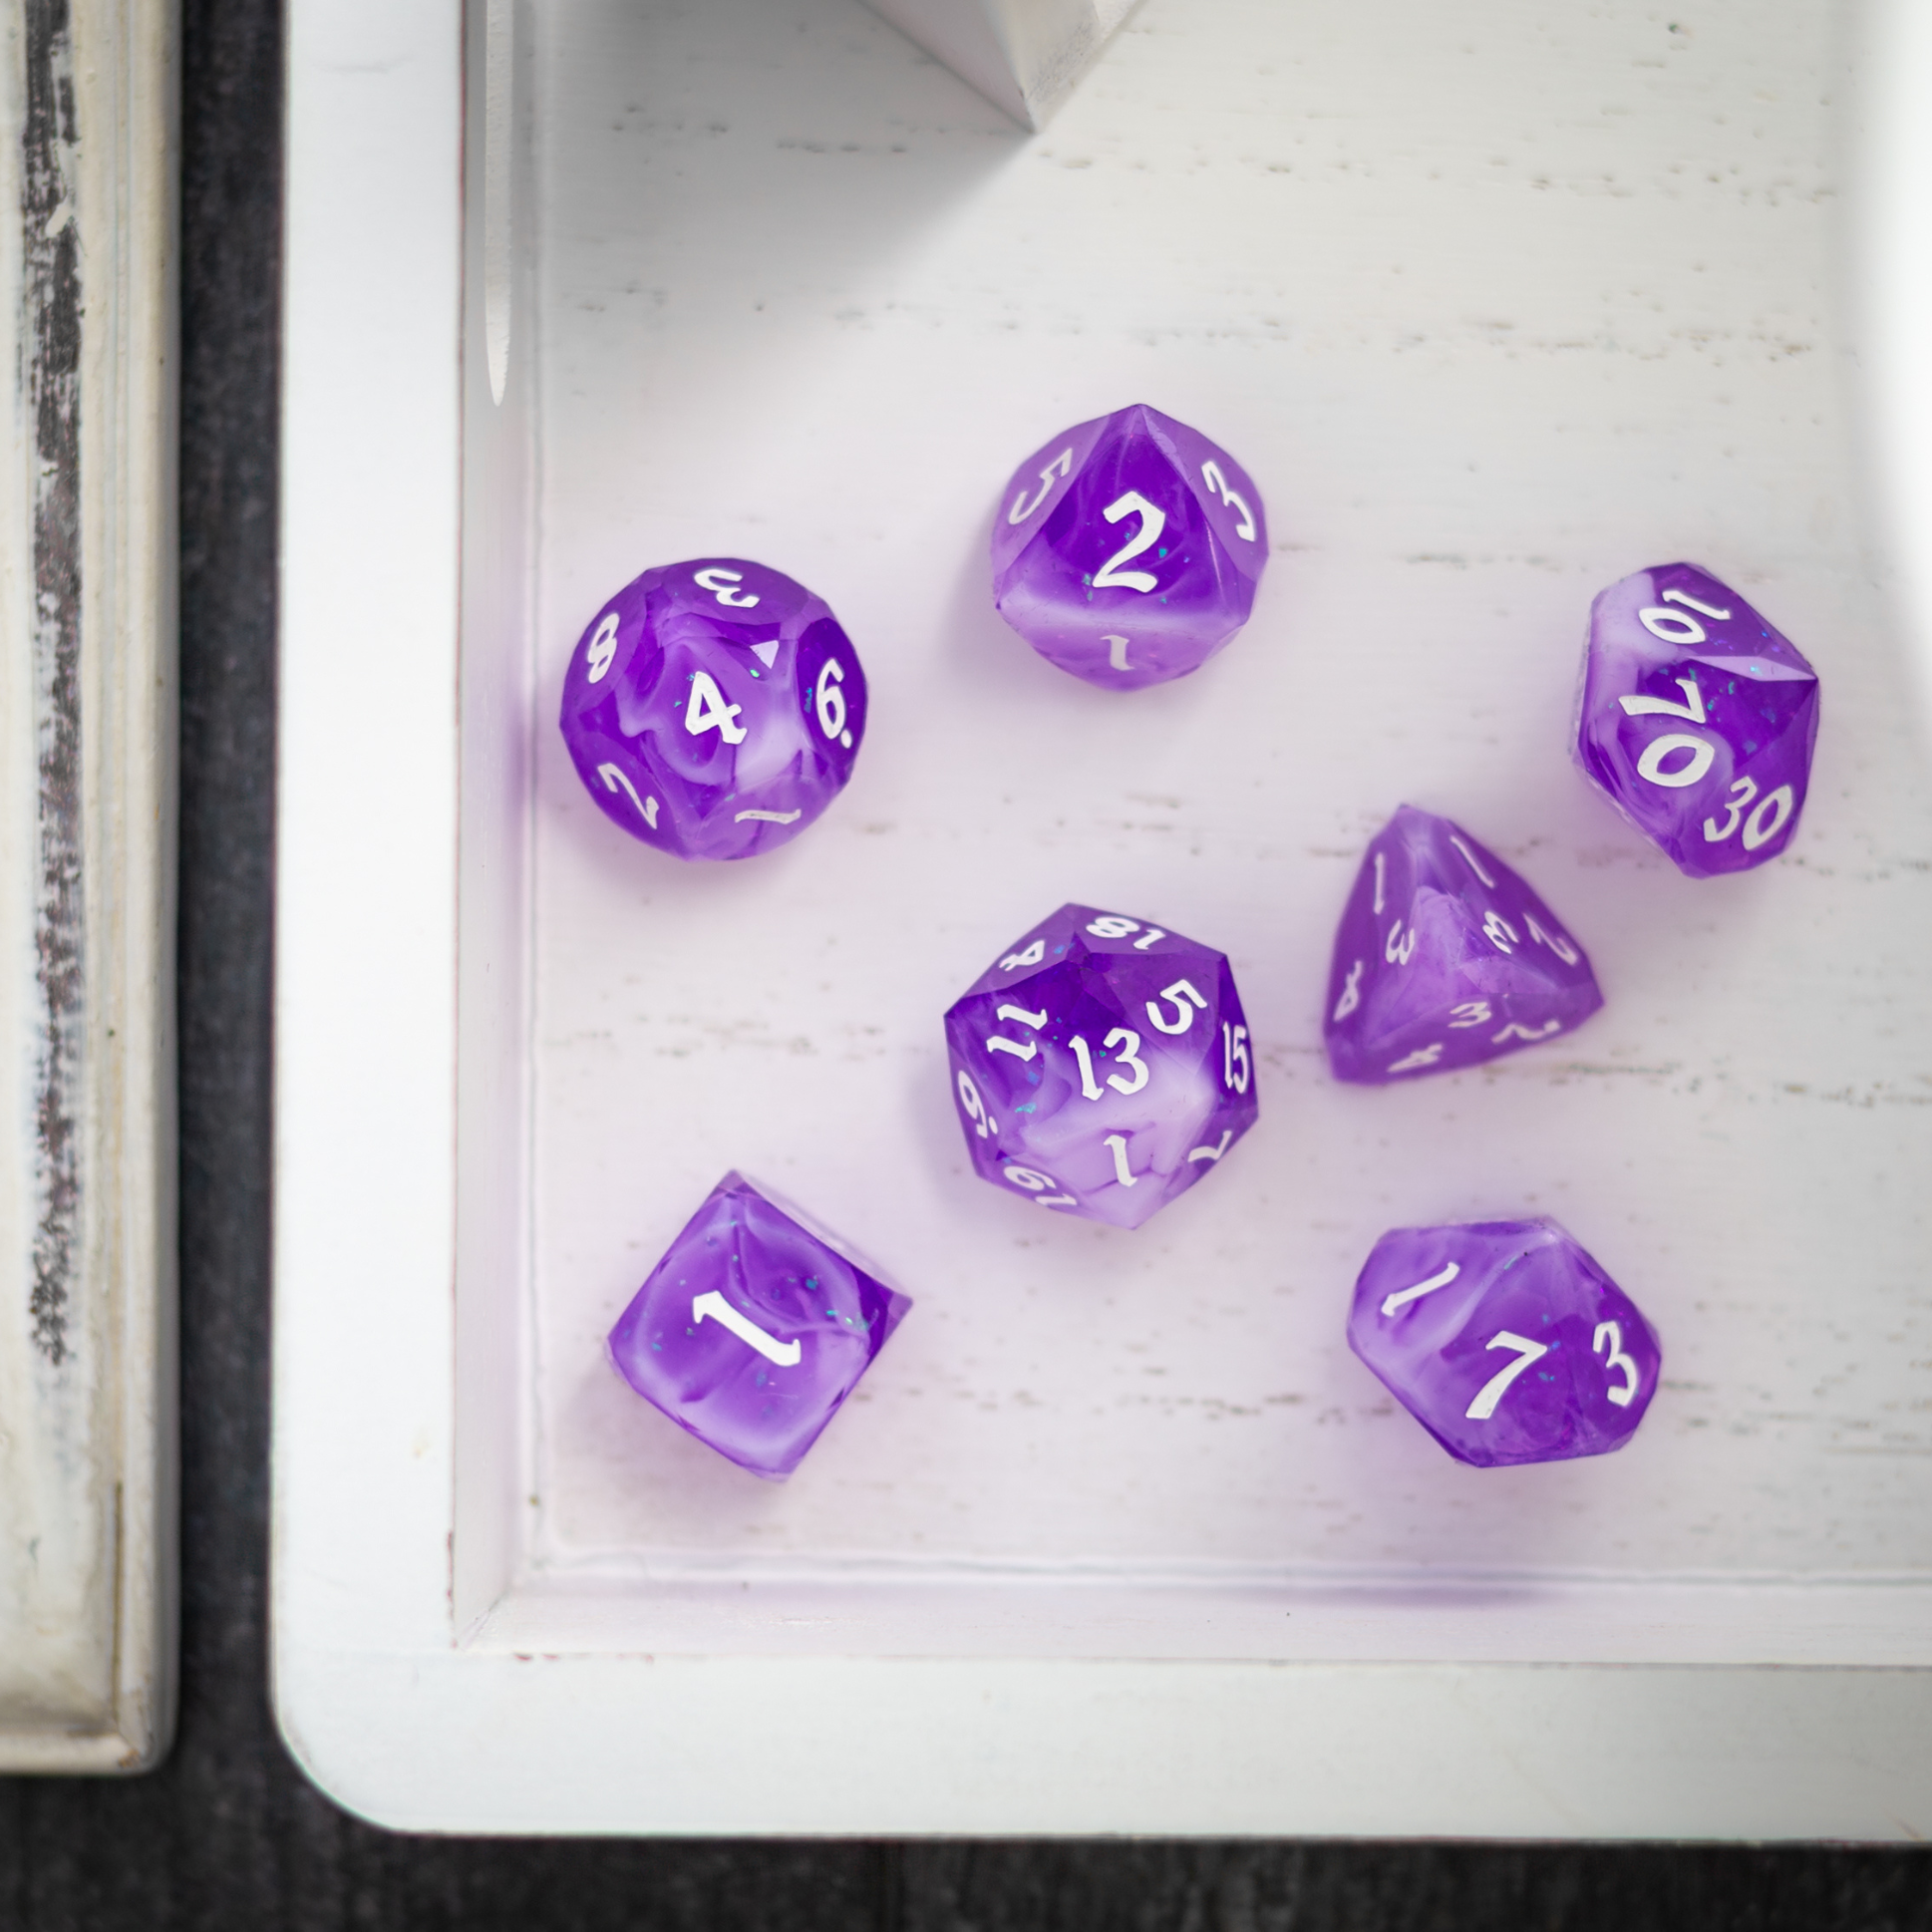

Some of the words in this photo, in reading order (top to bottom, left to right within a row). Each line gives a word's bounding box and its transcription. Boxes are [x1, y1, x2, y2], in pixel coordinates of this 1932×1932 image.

[1009, 448, 1073, 524] 5
[1201, 461, 1255, 541] 3
[1093, 491, 1165, 592] 2
[694, 568, 760, 608] 3
[1638, 589, 1731, 644] 10
[587, 612, 619, 684] 8
[1100, 634, 1136, 671] 1
[685, 671, 748, 745] 4
[1618, 678, 1715, 788] 70
[735, 808, 802, 824] 1
[1704, 776, 1792, 850] 30
[1374, 852, 1385, 915] 1
[1450, 835, 1494, 888] 1
[999, 940, 1045, 972] 4
[1086, 916, 1165, 950] 18
[1386, 919, 1415, 965] 3
[1482, 910, 1519, 954] 3
[1523, 912, 1578, 966] 2
[1145, 979, 1207, 1035] 5
[1333, 960, 1363, 1022] 4
[1448, 1001, 1492, 1028] 3
[986, 1004, 1048, 1062] 11
[1222, 1021, 1247, 1095] 15
[1387, 1044, 1444, 1074] 4
[1491, 1020, 1561, 1044] 2
[1068, 1027, 1149, 1101] 13
[1103, 1134, 1137, 1187] 1
[1188, 1130, 1232, 1162] 7
[1381, 1262, 1459, 1317] 1
[693, 1290, 801, 1367] 1
[1465, 1330, 1547, 1420] 7
[1593, 1321, 1637, 1407] 3
